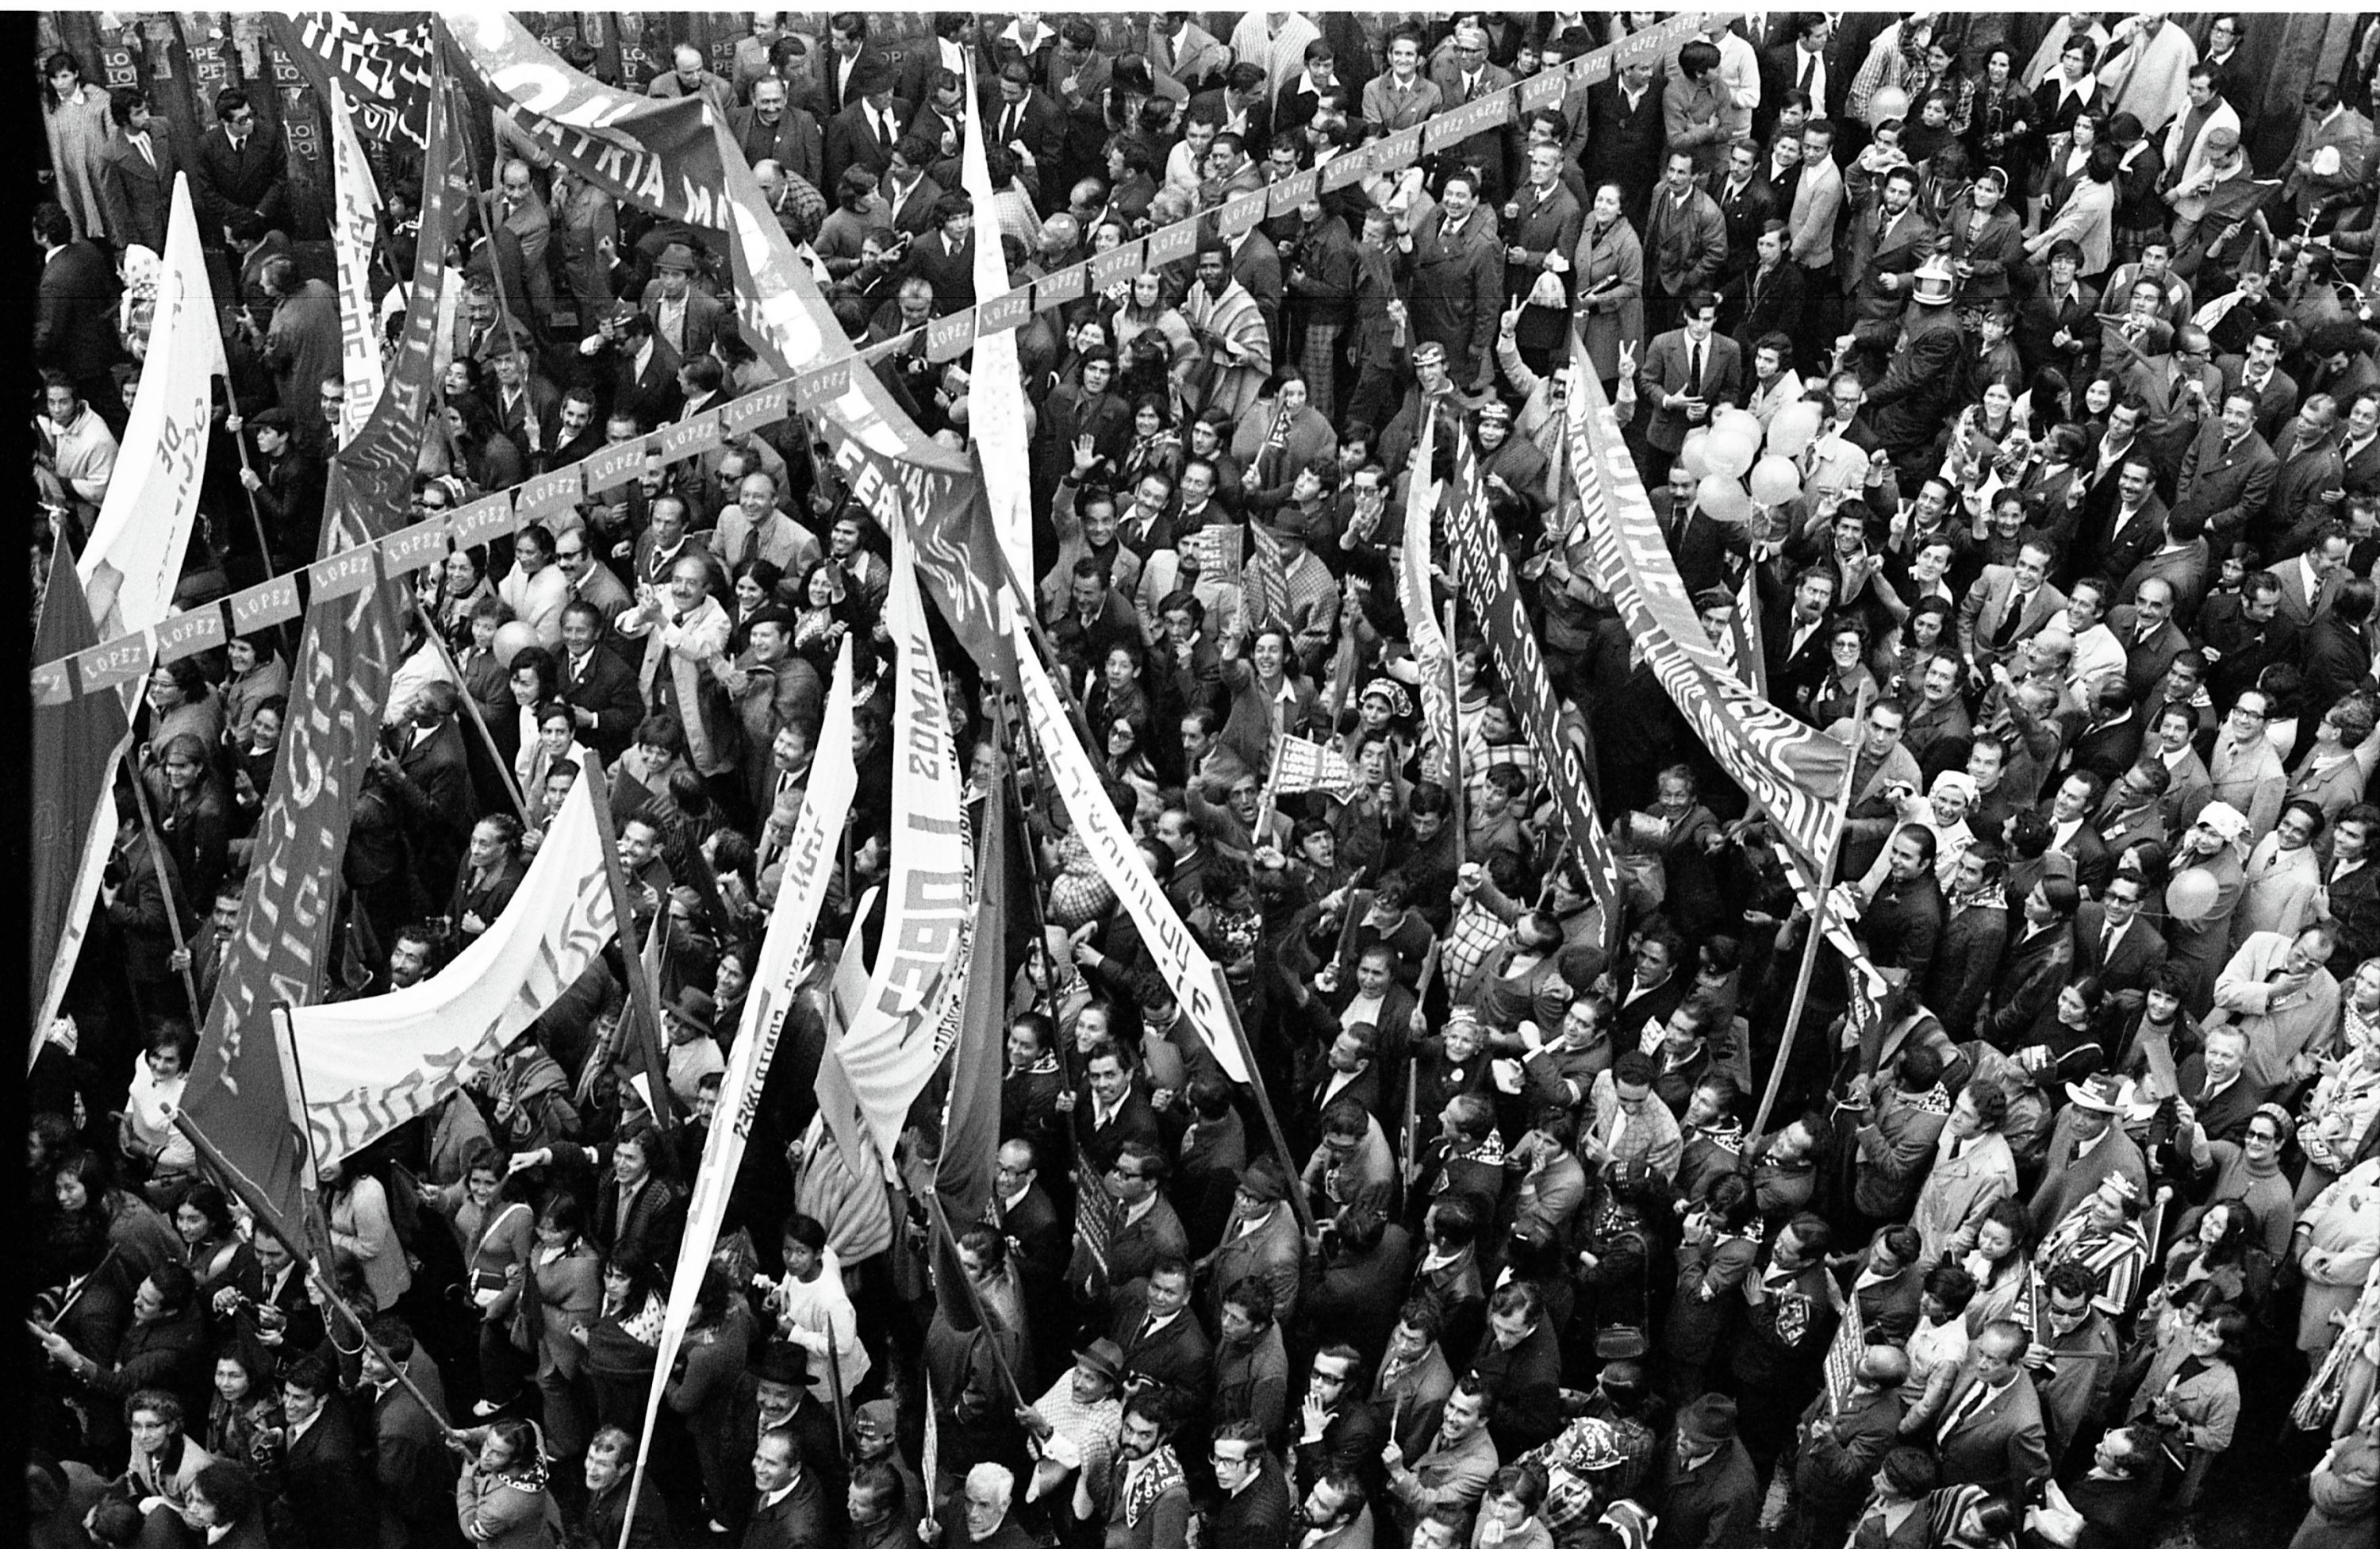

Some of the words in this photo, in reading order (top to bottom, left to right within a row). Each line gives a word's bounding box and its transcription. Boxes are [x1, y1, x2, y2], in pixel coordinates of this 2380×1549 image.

[84, 647, 140, 679] LOPEZ
[161, 618, 216, 648] LOPEZ
[237, 589, 290, 620] LOPEZ
[316, 555, 369, 587] LOPEZ
[390, 532, 441, 560] LOPEZ
[457, 505, 506, 536] LOPEZ
[526, 479, 574, 507] LOPEZ
[595, 453, 642, 479] LOPEZ
[667, 423, 713, 451] LOPEZ
[737, 394, 781, 421] LOPEZ
[803, 371, 846, 399] LOPEZ
[929, 322, 970, 348] LOPEZ
[985, 300, 1026, 326] LOPEZ
[1039, 272, 1081, 296] LOPEZ
[1099, 253, 1138, 278] LOPEZ
[1152, 231, 1192, 254] LOPEZ
[1224, 201, 1261, 224] LOPEZ
[1275, 179, 1313, 202] LOPEZ
[1327, 156, 1364, 179] LOPEZ
[1379, 140, 1416, 163] LOPEZ
[1427, 120, 1464, 142] LOPEZ
[1469, 100, 1504, 122] LOPEZ
[1526, 77, 1561, 100] LOPEZ
[1459, 501, 1495, 604] BARRIO
[1458, 415, 1507, 592] VAMOS
[1512, 598, 1551, 708] CON
[1551, 707, 1618, 896] LOPEZ
